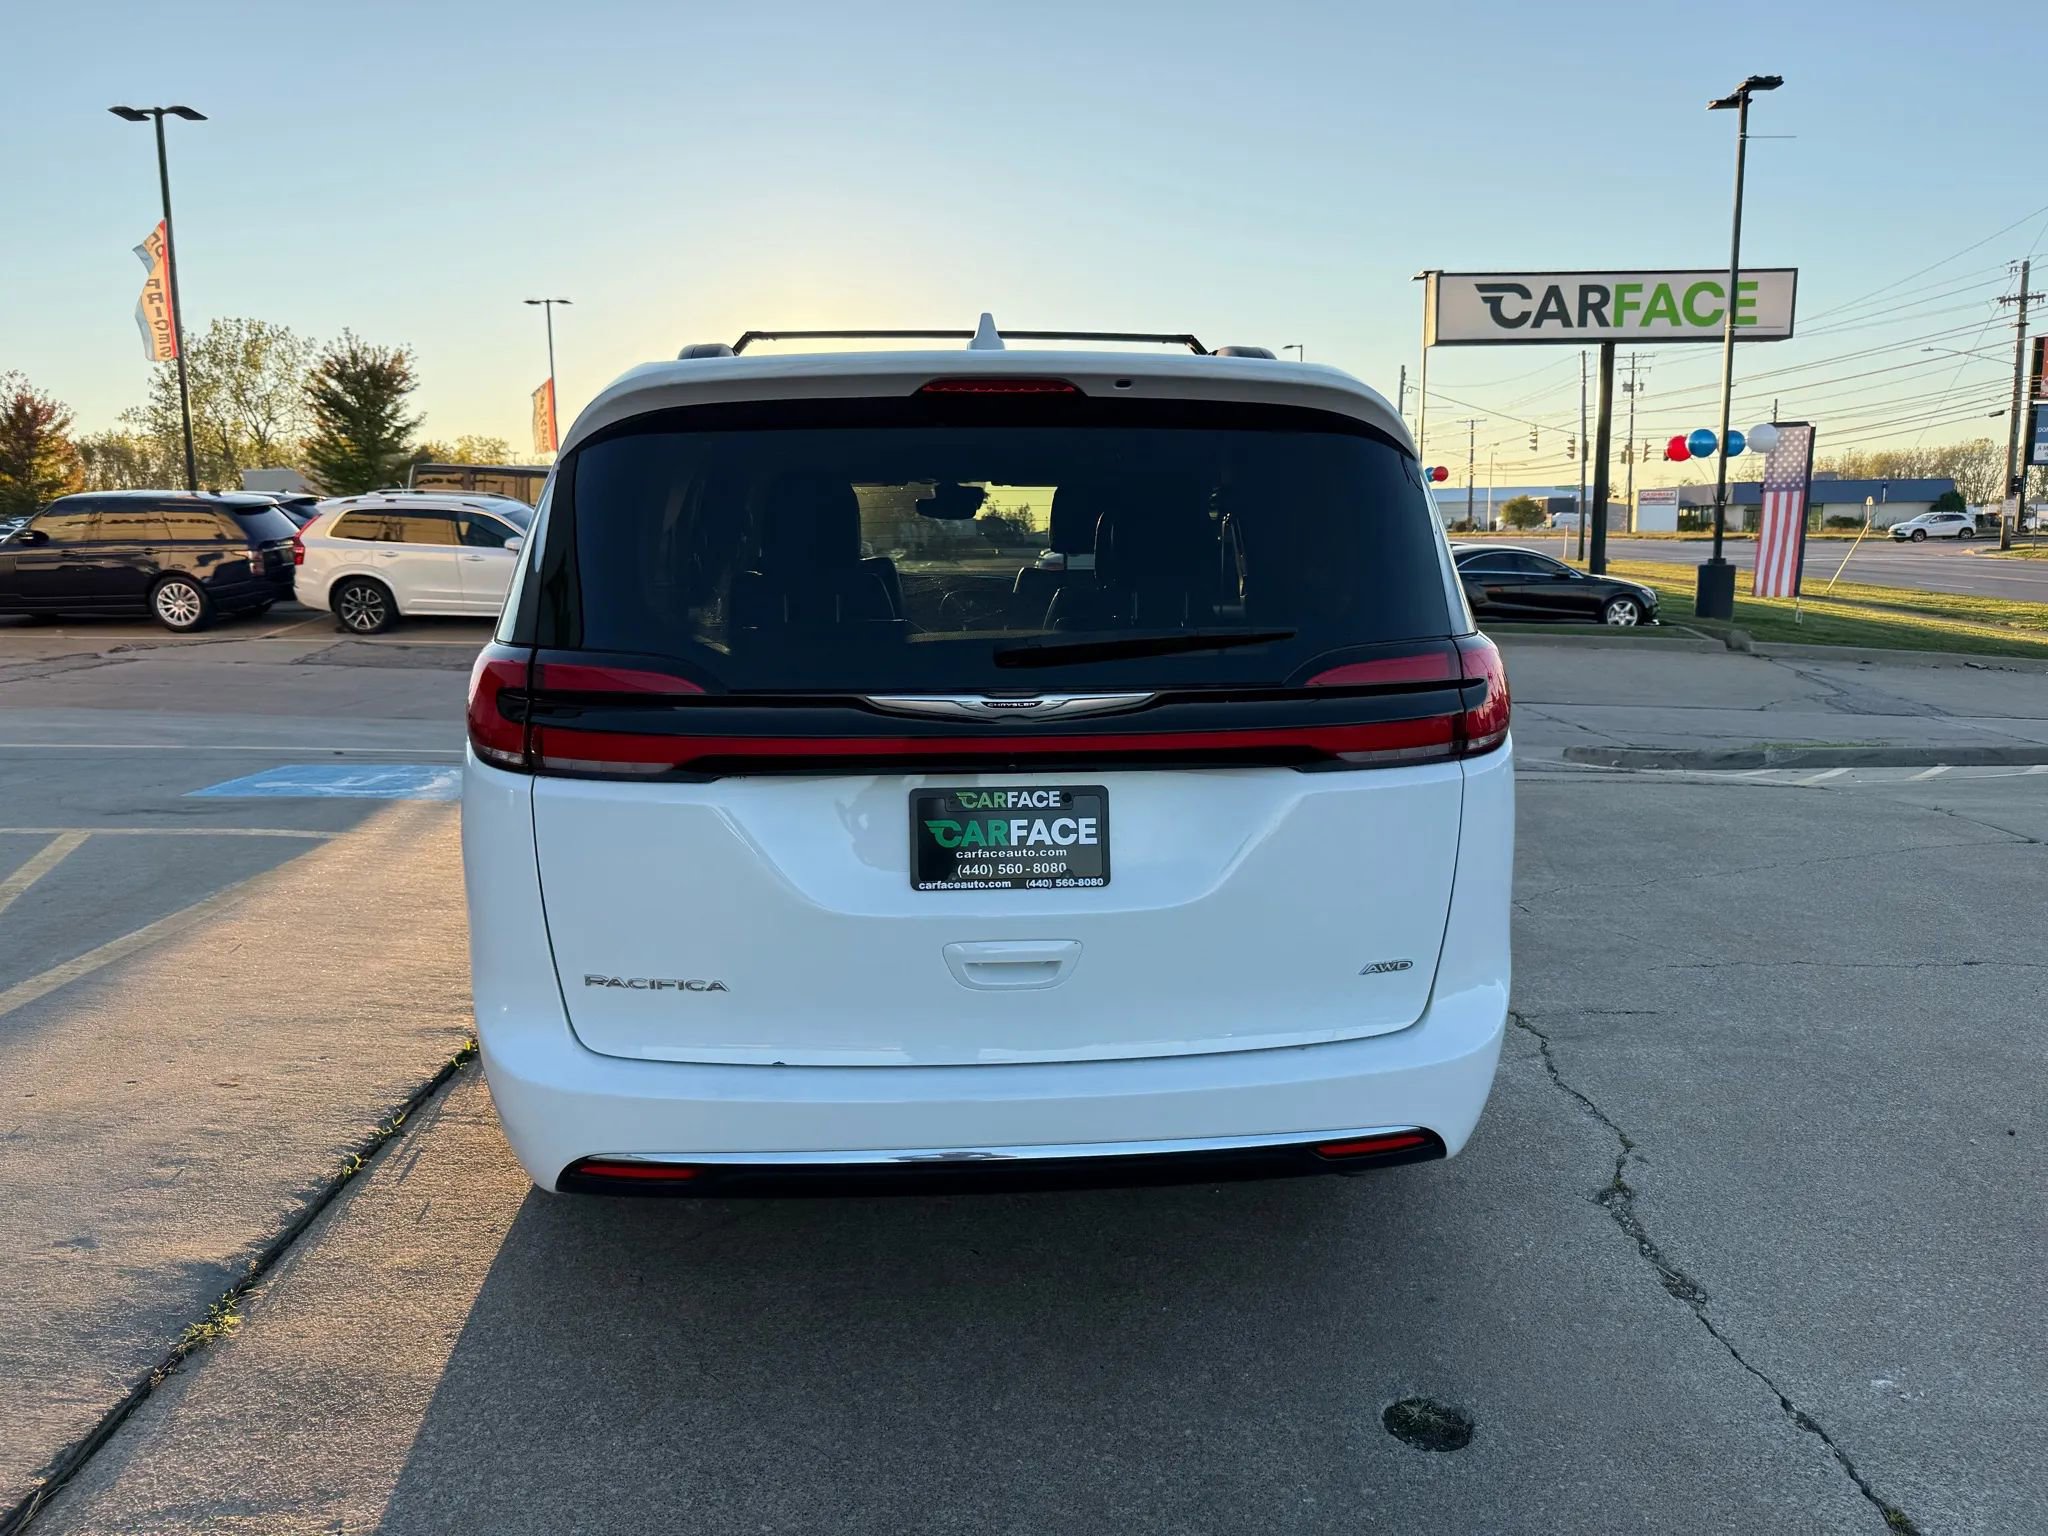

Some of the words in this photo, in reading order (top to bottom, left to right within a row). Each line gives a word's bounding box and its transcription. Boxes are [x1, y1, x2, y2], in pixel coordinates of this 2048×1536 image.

[1474, 281, 1759, 329] CARFACE
[956, 790, 1061, 809] CARFACE
[924, 817, 1098, 847] CARFACE
[955, 849, 1067, 859] carfaceauto.com
[957, 864, 993, 878] (440)
[918, 879, 1012, 890] carfaceauto.com
[1025, 878, 1053, 888] (440)
[1055, 877, 1104, 887] 560-8080
[1359, 960, 1413, 975] AWD
[584, 974, 730, 992] PACIFICA
